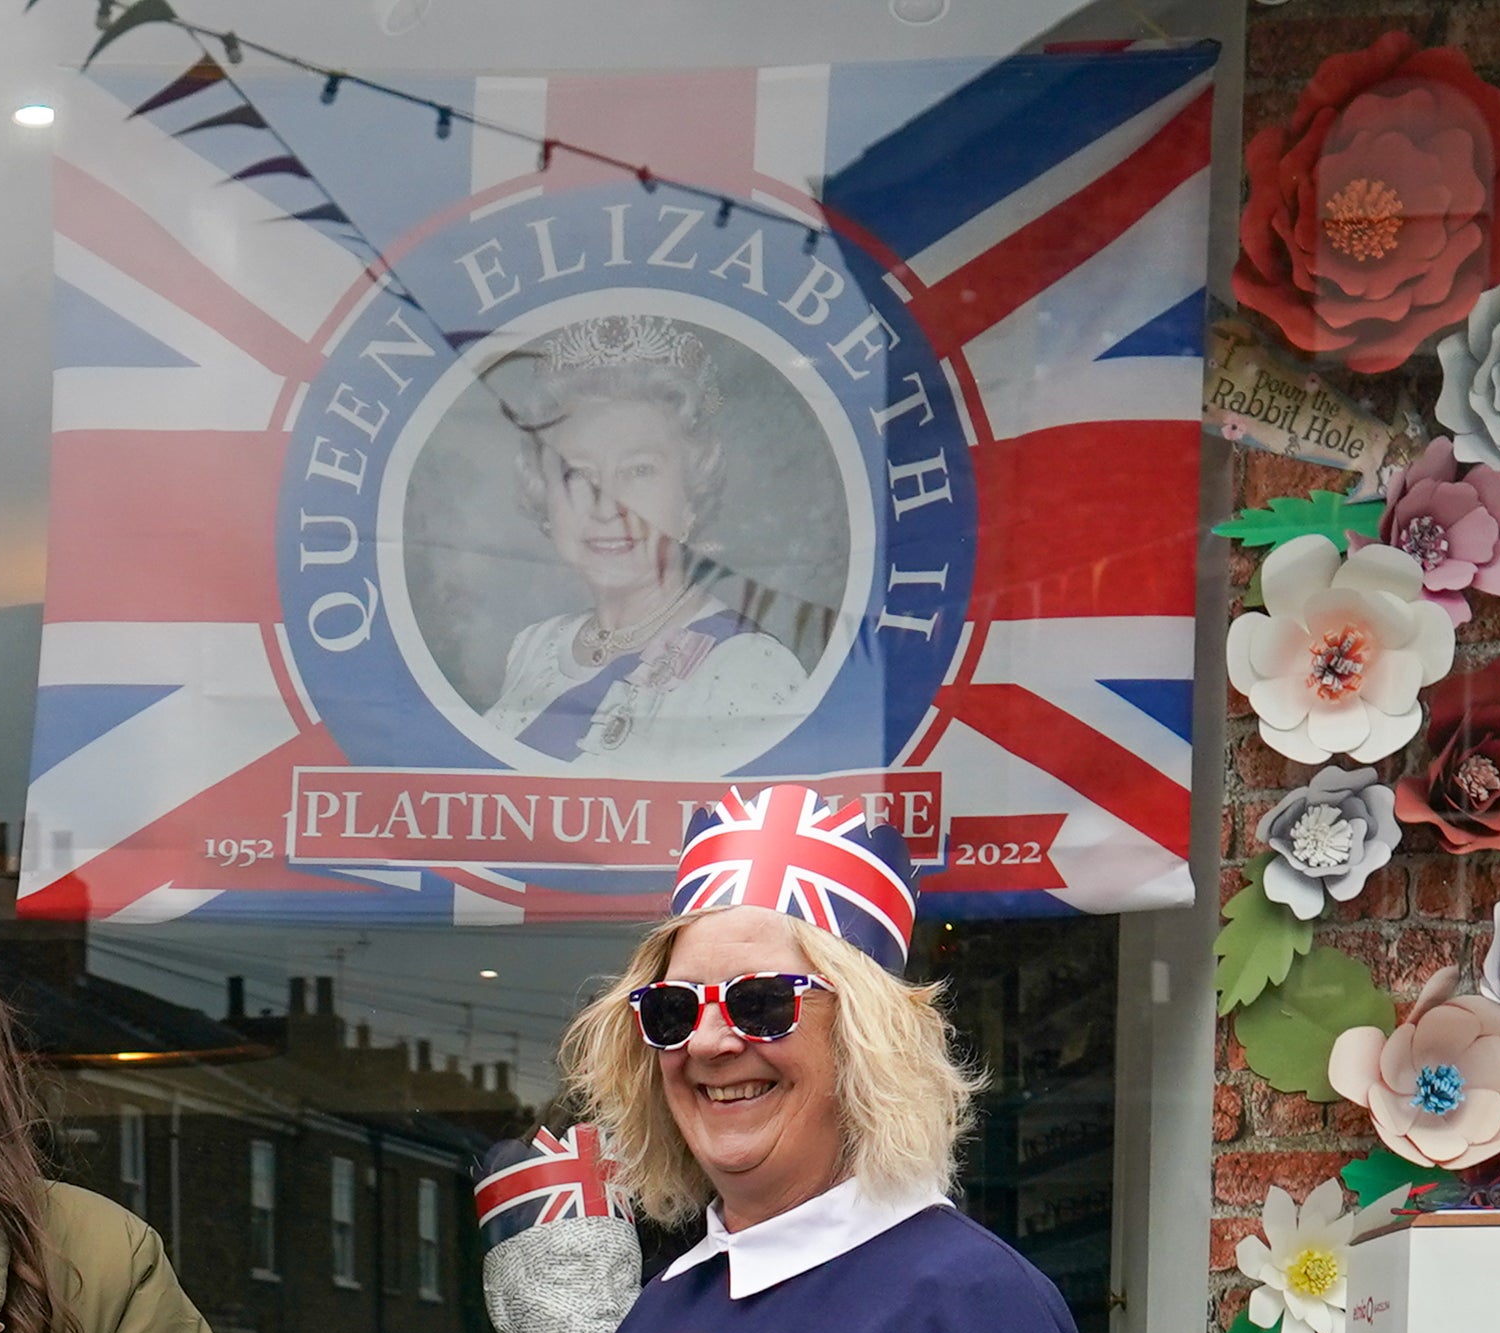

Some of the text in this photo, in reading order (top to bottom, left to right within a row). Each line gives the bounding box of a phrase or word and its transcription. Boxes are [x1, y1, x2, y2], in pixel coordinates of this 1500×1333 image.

[1211, 377, 1366, 459] Rabbit Hole
[1255, 370, 1340, 417] Down the
[300, 304, 436, 652] QUEEN
[454, 203, 953, 521] ELIZABETH
[303, 791, 652, 845] PLATINUM
[205, 838, 275, 868] 1952
[956, 840, 1044, 868] 2022
